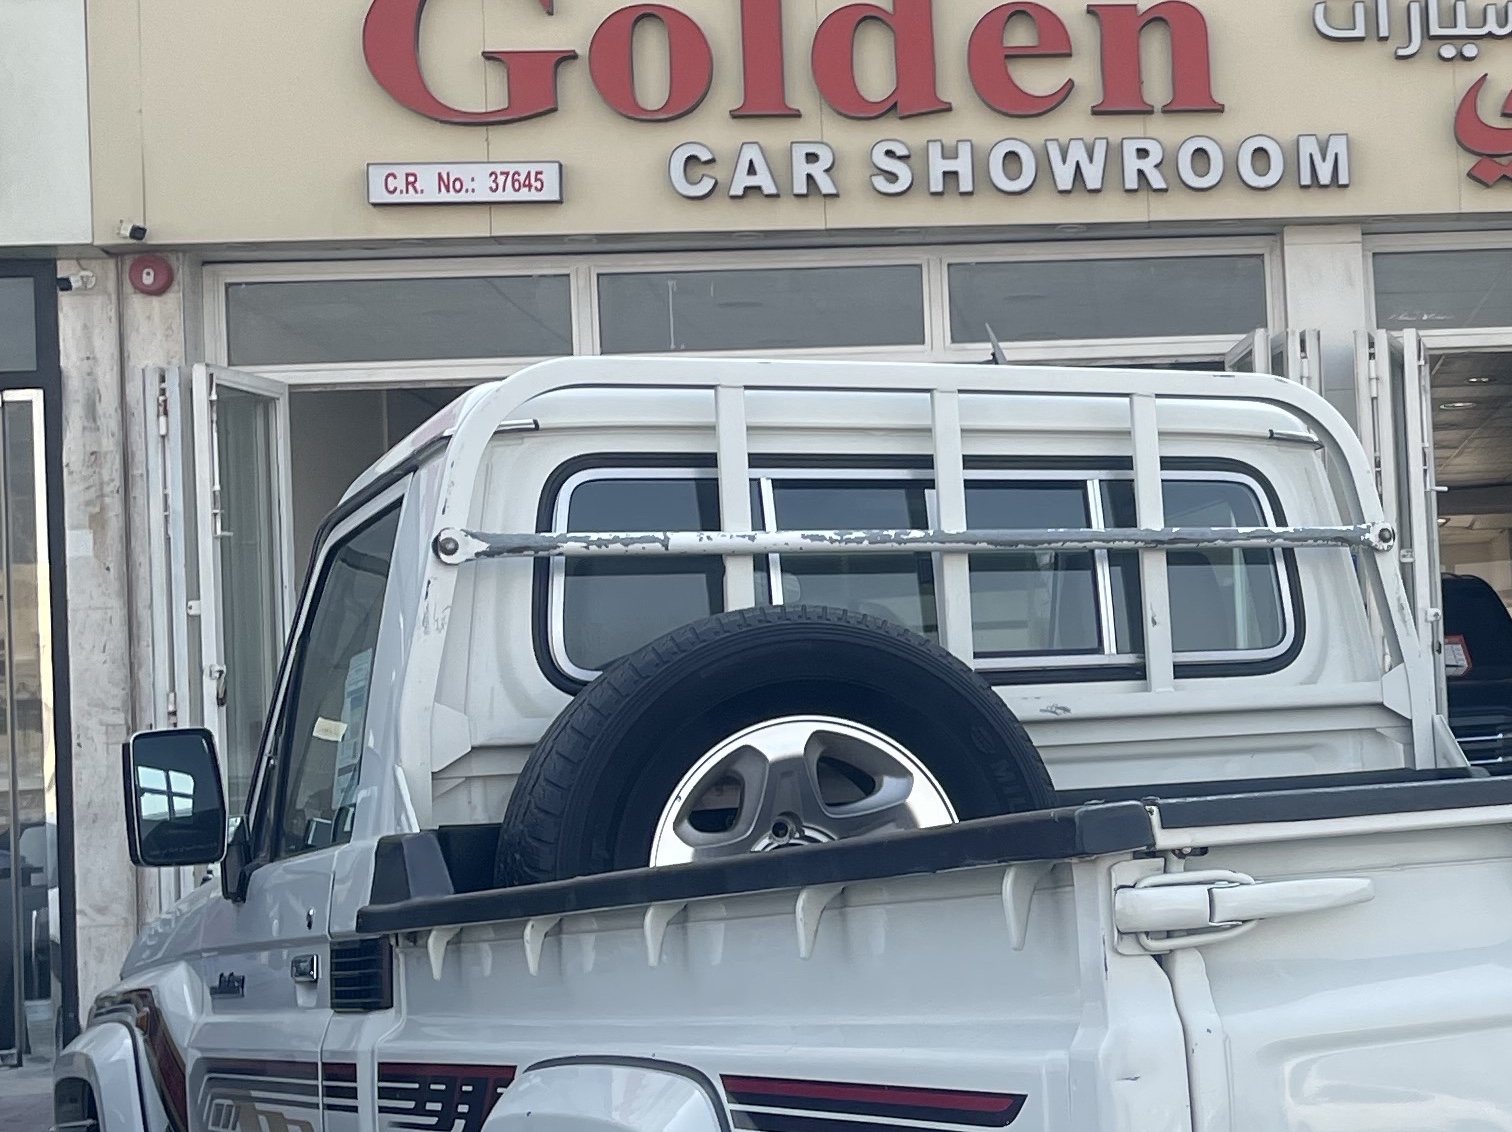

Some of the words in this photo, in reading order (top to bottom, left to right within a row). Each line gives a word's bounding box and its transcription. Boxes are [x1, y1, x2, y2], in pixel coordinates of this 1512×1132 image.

[361, 0, 1226, 127] Golden
[383, 171, 426, 196] C.R.
[436, 171, 479, 195] No.:
[488, 169, 545, 194] 37645
[667, 140, 840, 200] CAR
[869, 132, 1351, 197] SHOWROOM
